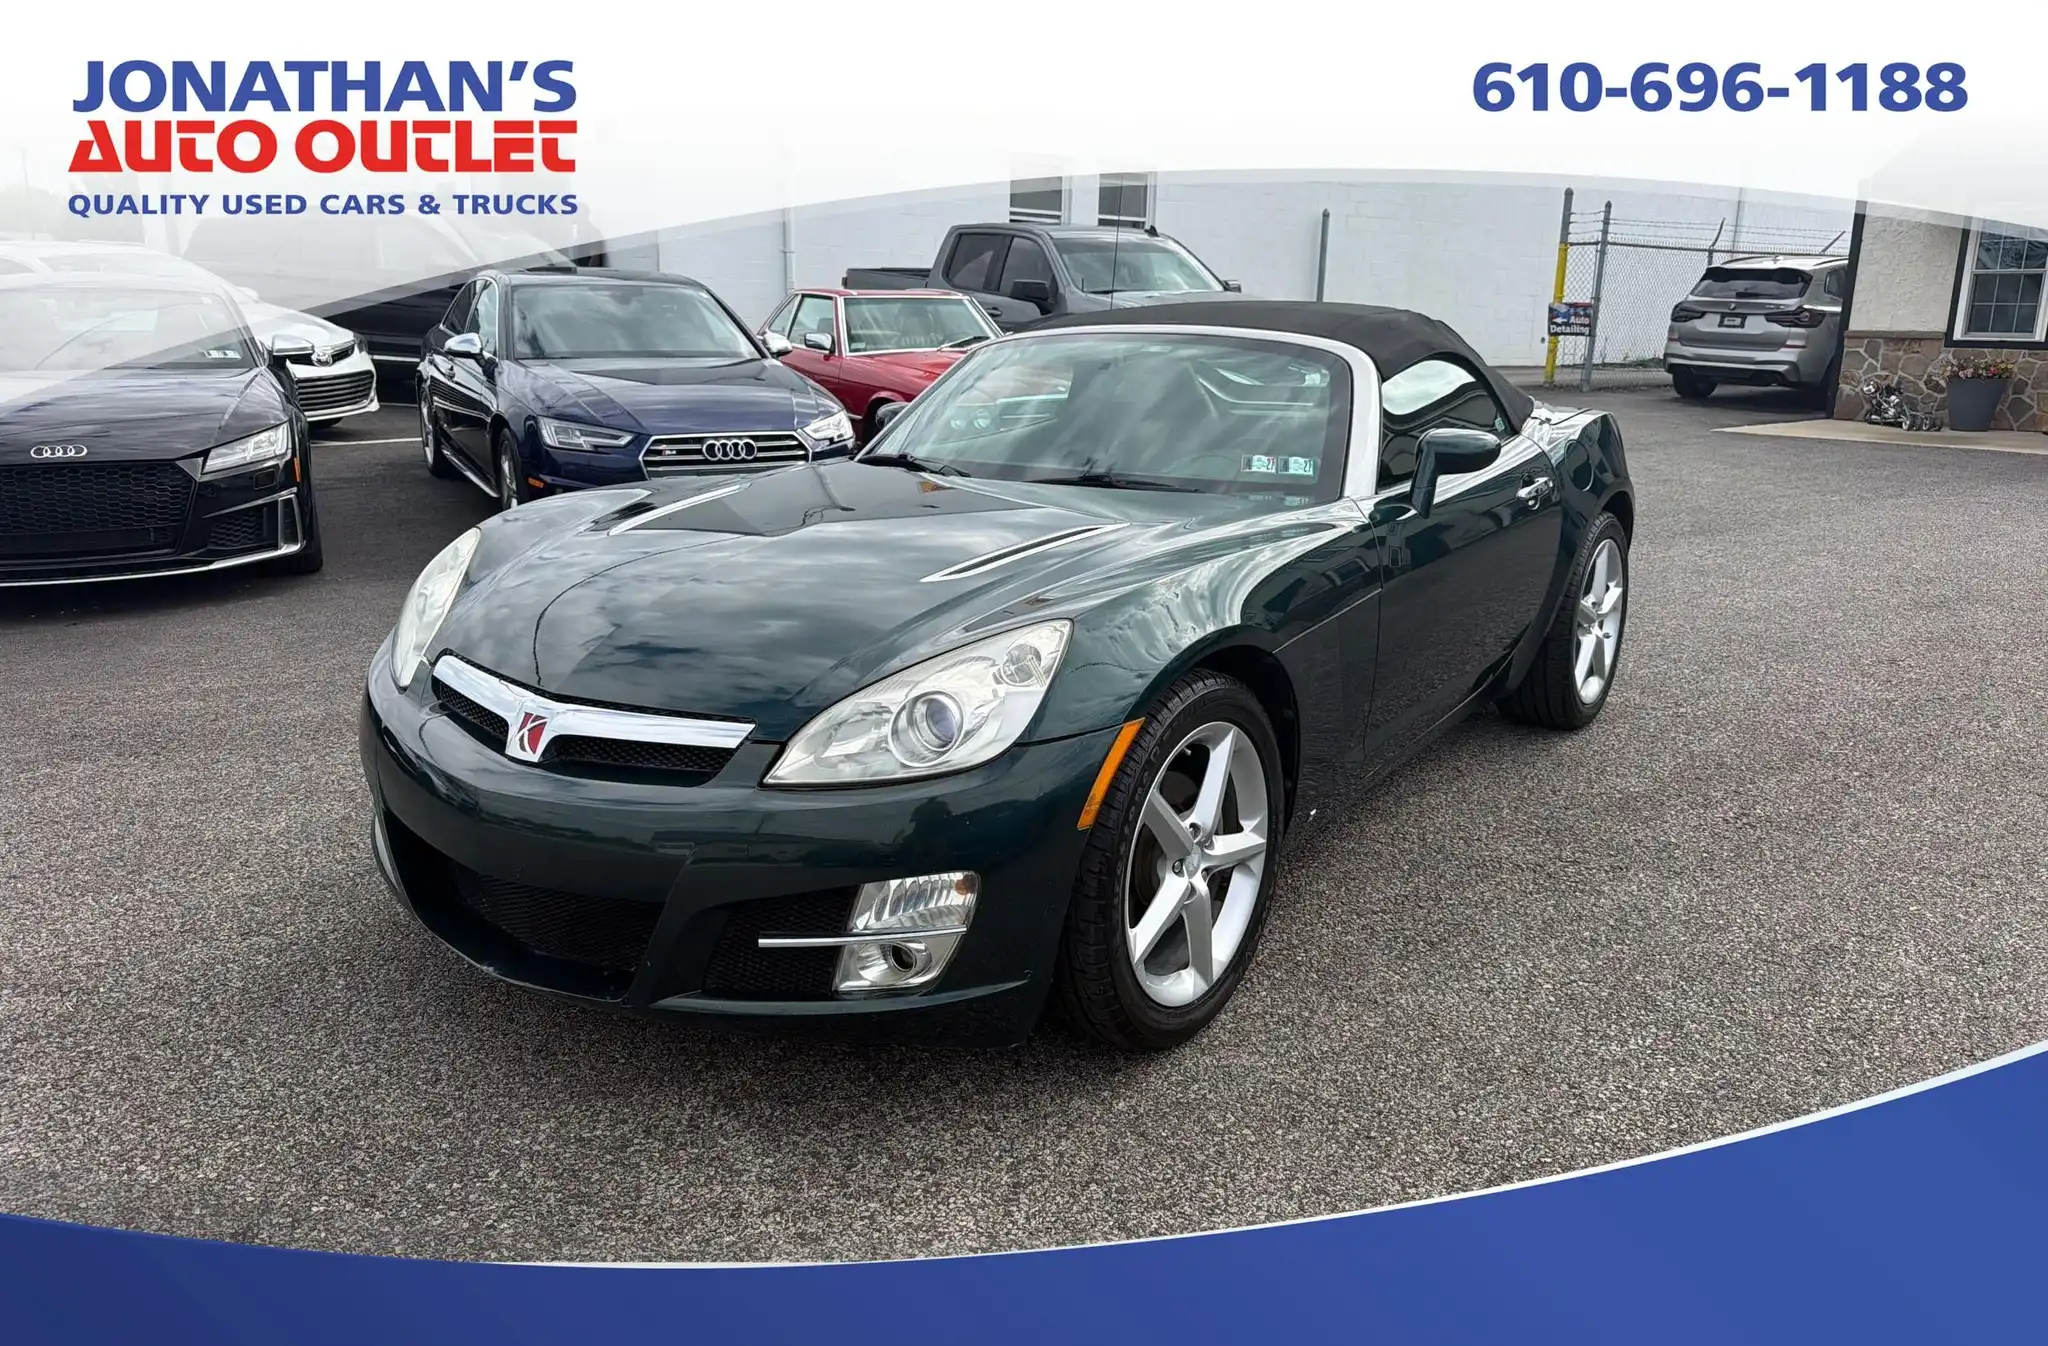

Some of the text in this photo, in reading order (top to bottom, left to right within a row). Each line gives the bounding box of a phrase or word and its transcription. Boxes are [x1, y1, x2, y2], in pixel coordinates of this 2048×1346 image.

[1569, 315, 1589, 324] Auto
[1550, 325, 1589, 335] Detailing
[1303, 459, 1312, 473] 27
